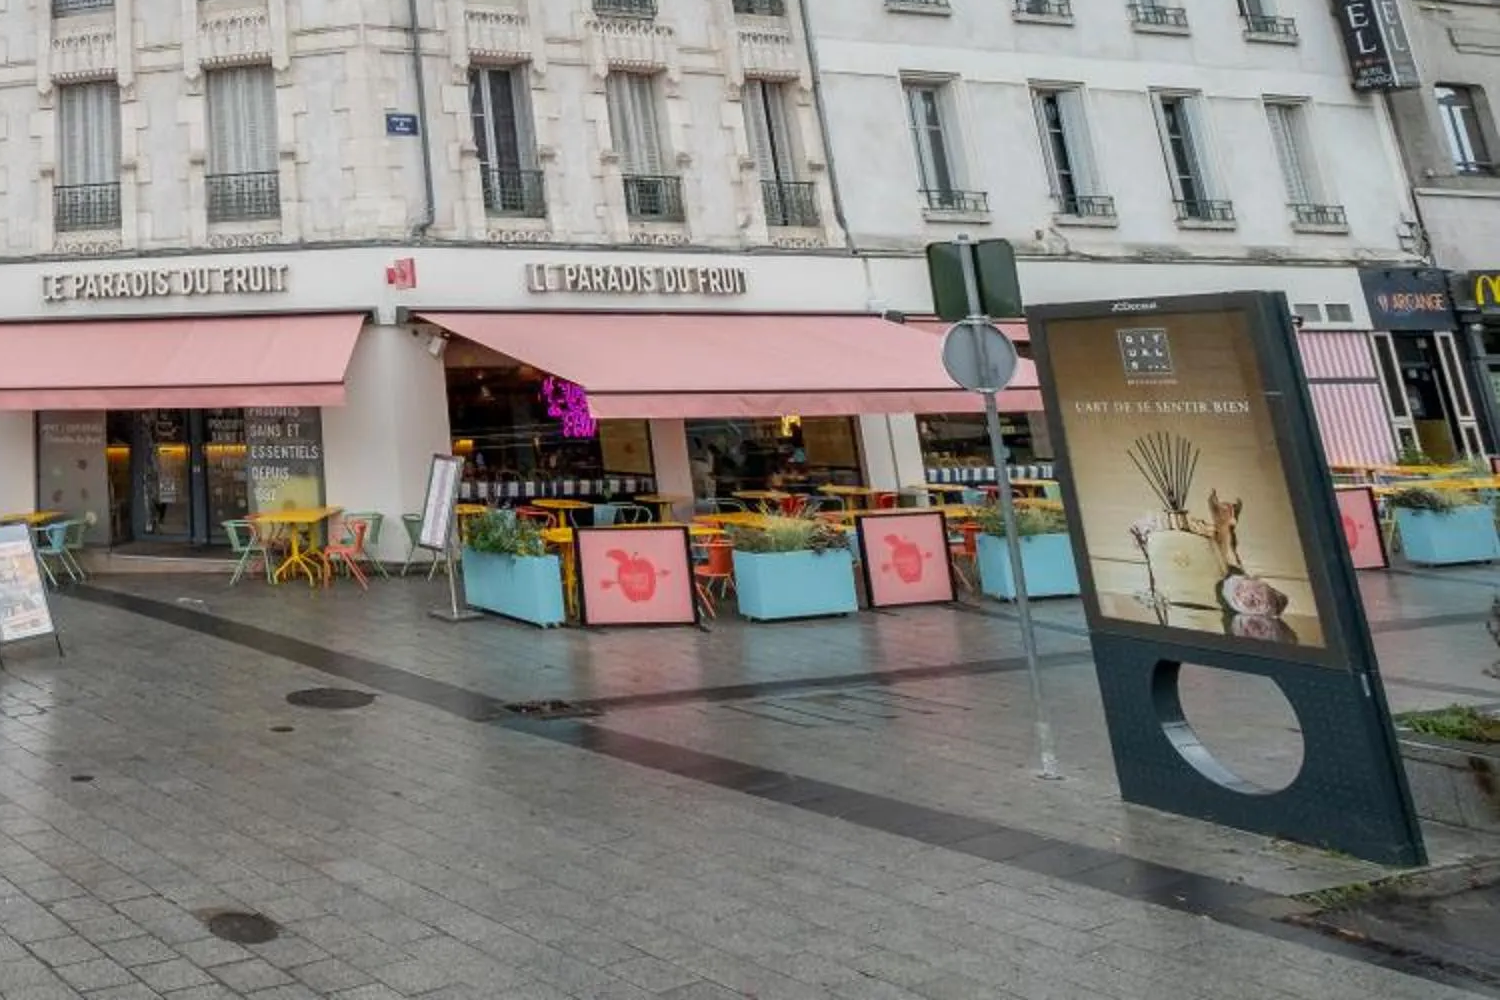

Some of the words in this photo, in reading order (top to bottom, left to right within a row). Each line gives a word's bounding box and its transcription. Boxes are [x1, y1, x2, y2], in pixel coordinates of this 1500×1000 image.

[44, 274, 64, 300] LE
[73, 269, 170, 299] PARADIS
[180, 266, 209, 295] DU
[221, 264, 288, 293] FRUIT
[532, 264, 557, 292] LE
[565, 265, 655, 293] PARADIS
[664, 267, 691, 293] DU
[699, 267, 748, 294] FRUIT
[1213, 401, 1250, 414] BIEN
[249, 423, 281, 437] SAINS
[286, 423, 300, 437] ET
[250, 445, 320, 459] ESSENTIELS
[250, 466, 291, 481] DEPUIS
